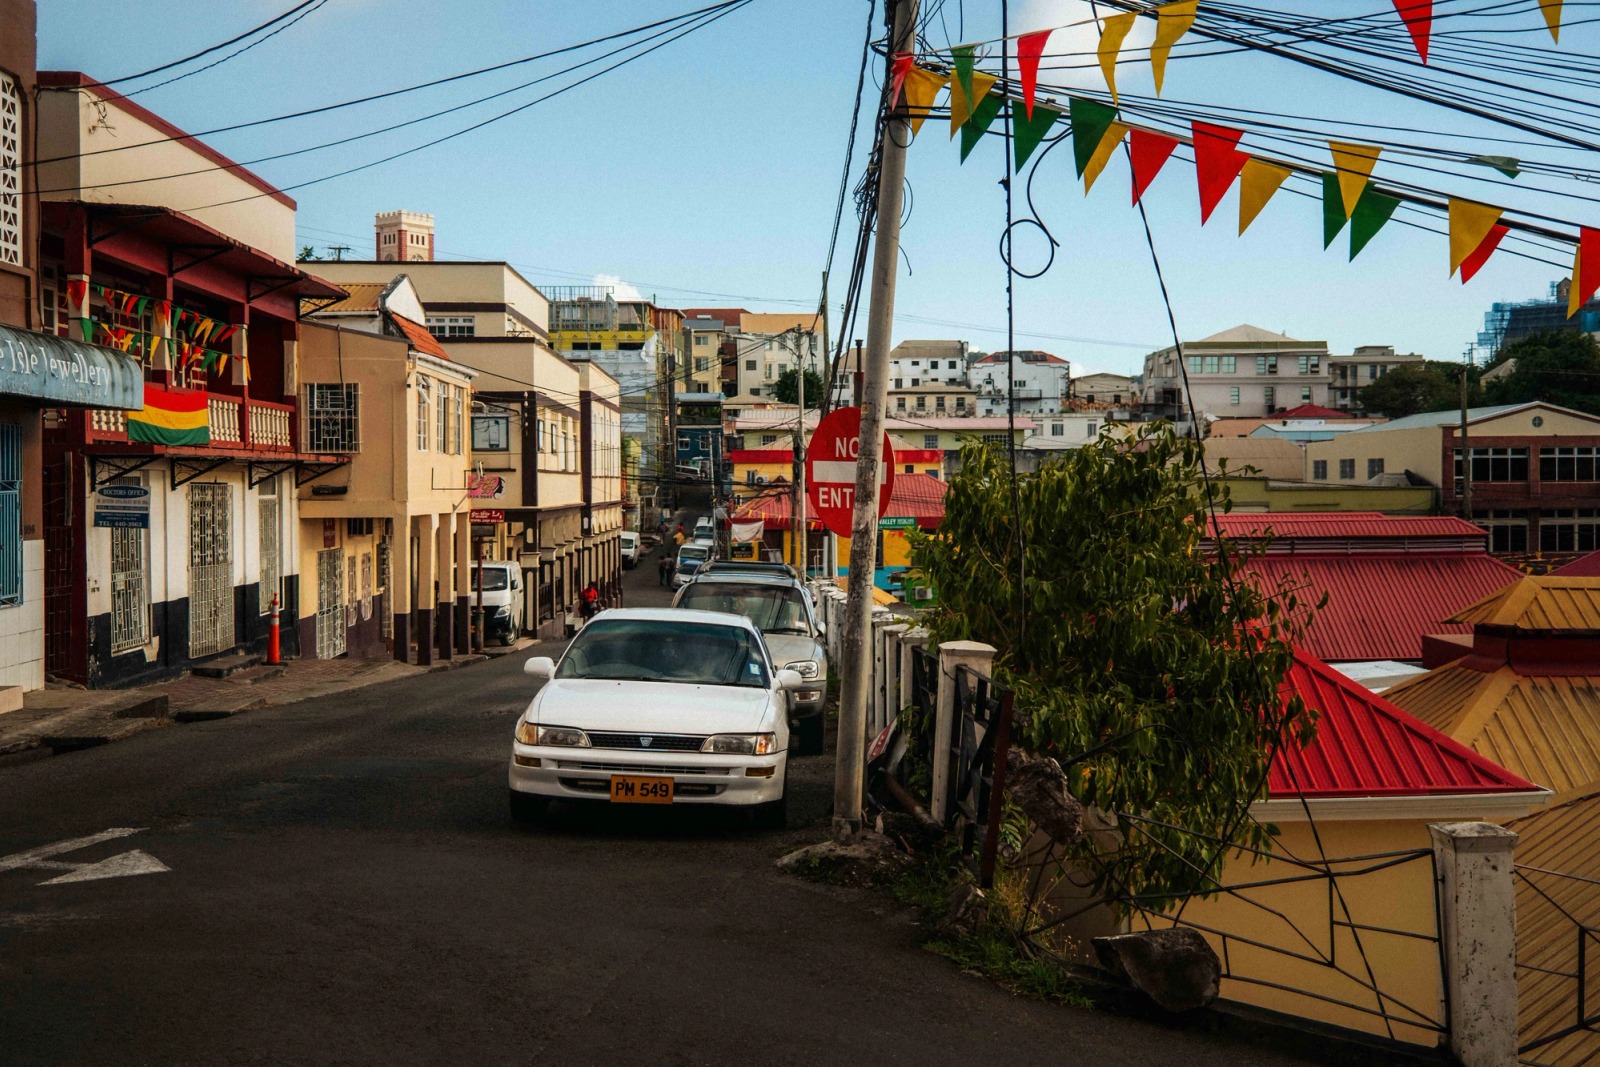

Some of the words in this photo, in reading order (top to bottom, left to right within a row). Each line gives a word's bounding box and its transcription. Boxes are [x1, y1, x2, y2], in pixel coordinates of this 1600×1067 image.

[5, 339, 38, 375] Isle
[38, 346, 111, 396] Jewellery
[835, 437, 859, 458] NO
[818, 487, 853, 509] ENT
[615, 782, 635, 797] PM
[639, 782, 669, 797] 549
